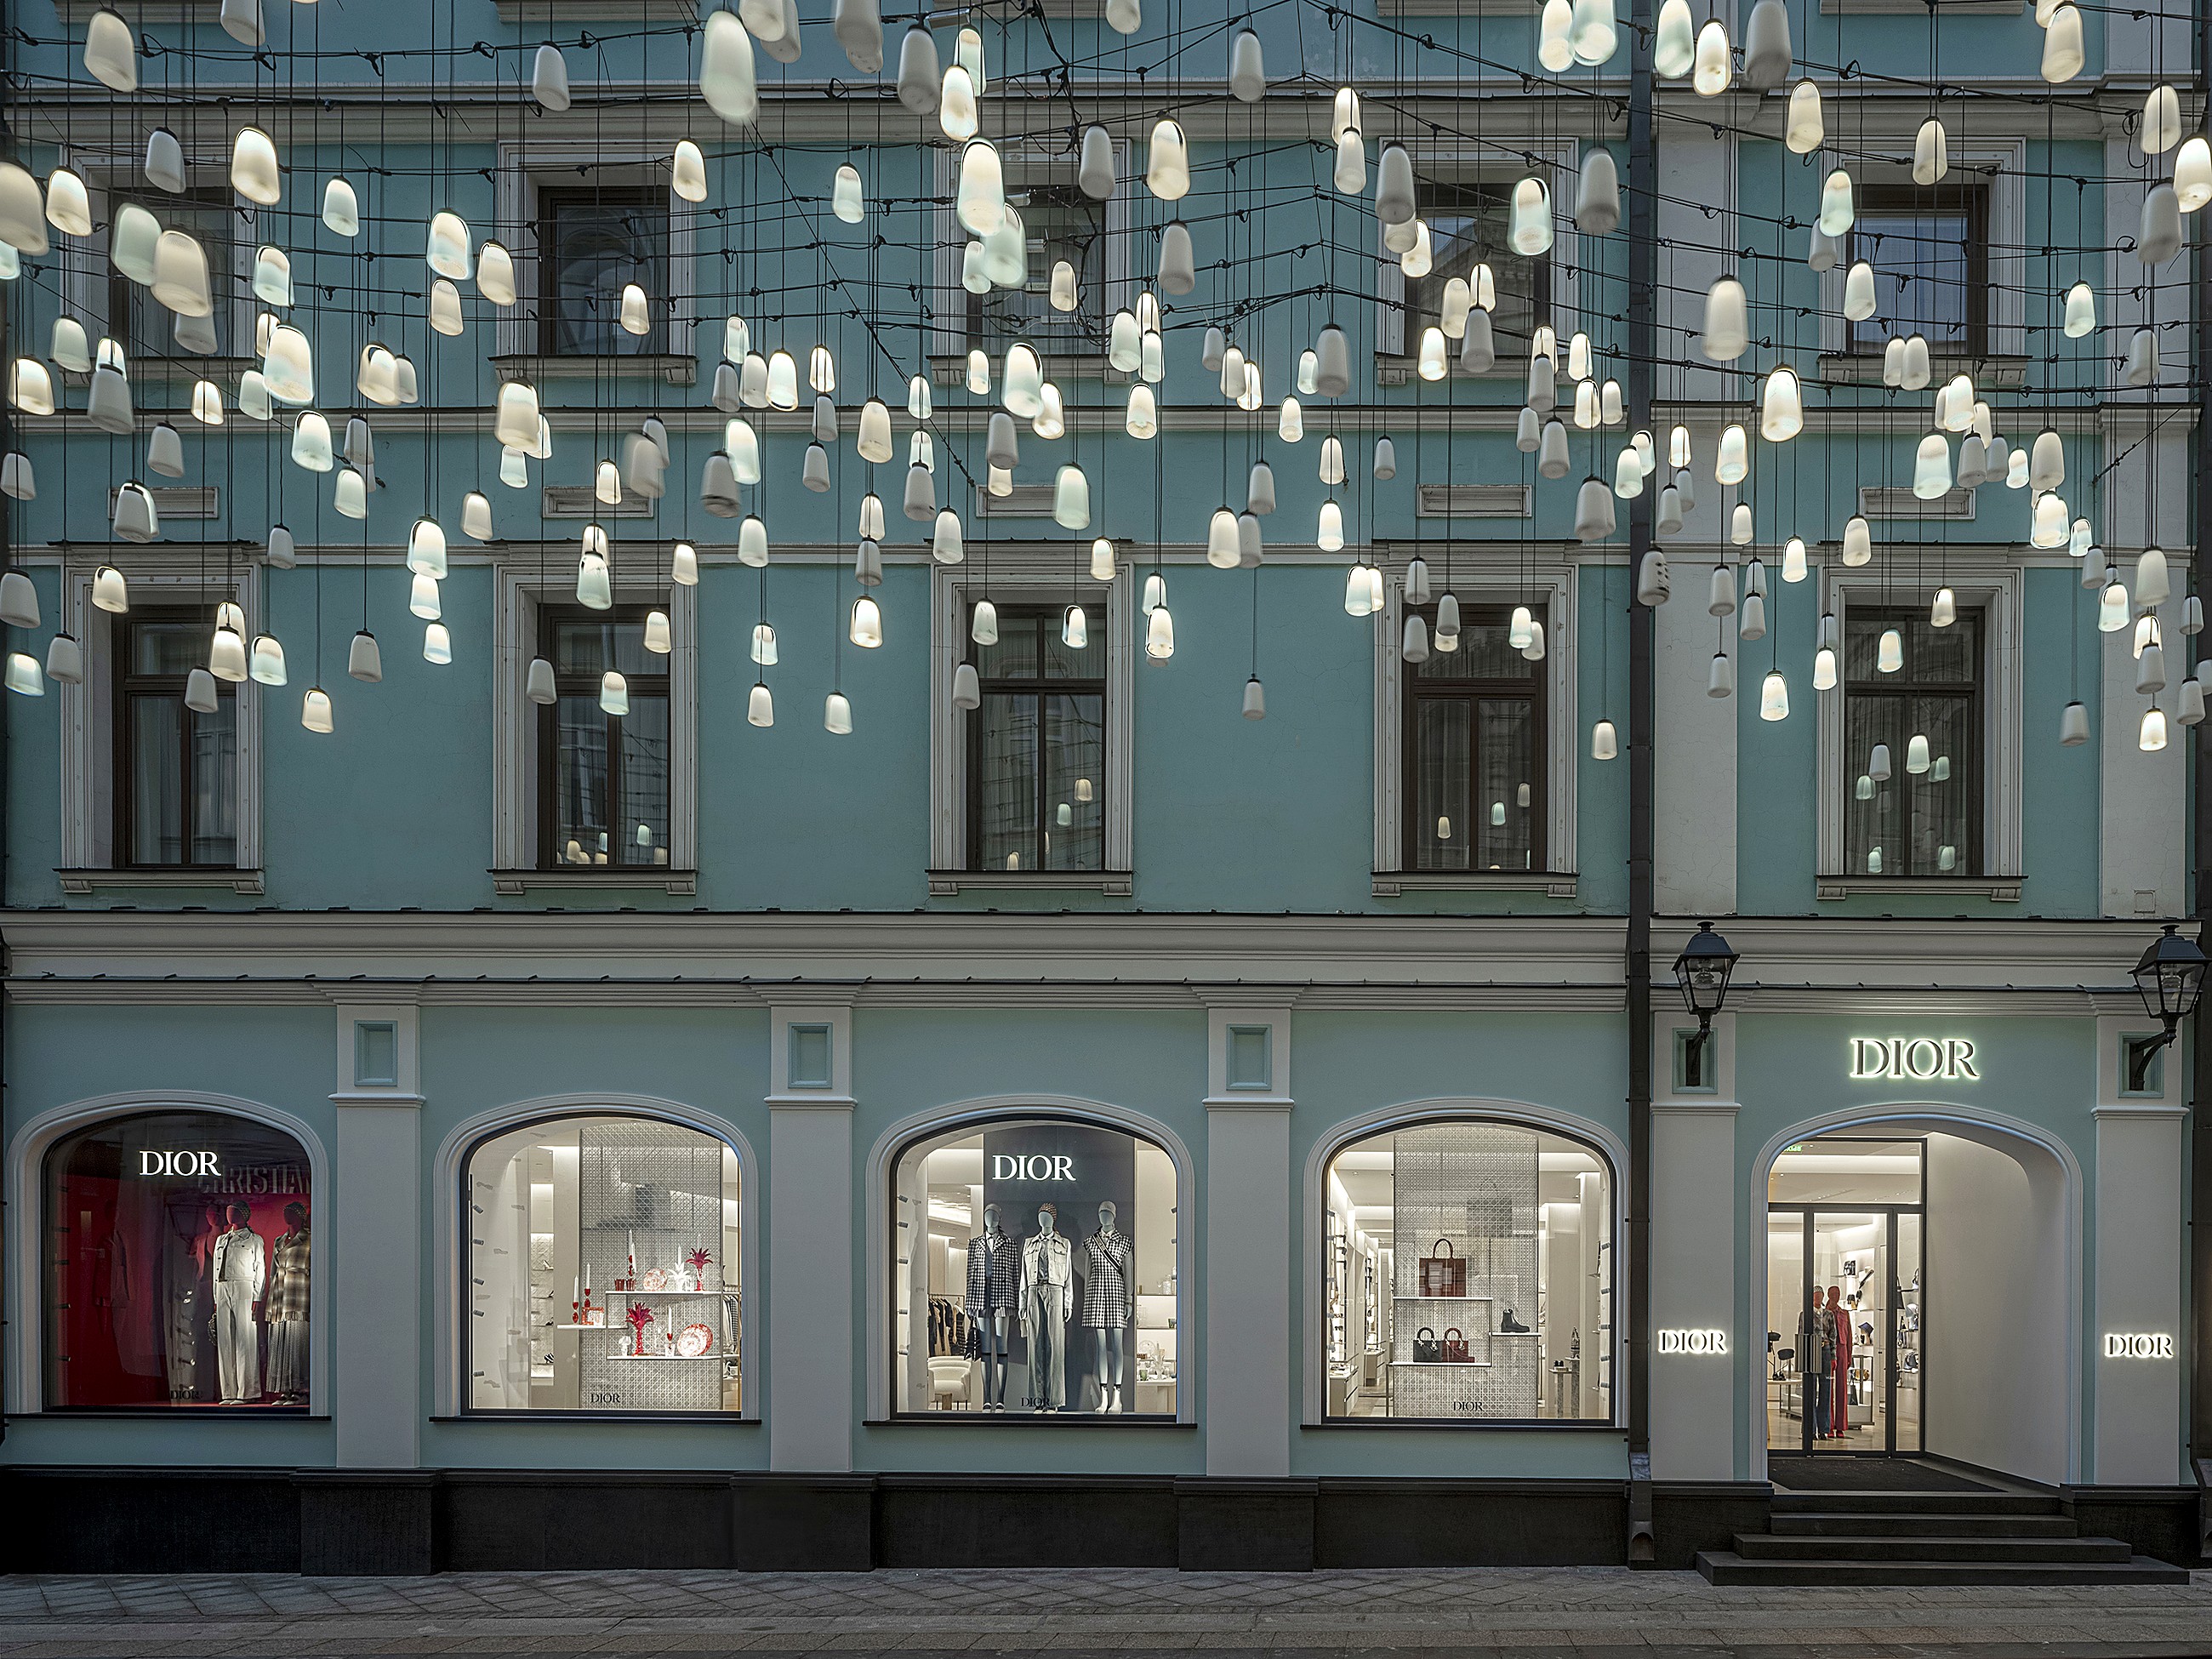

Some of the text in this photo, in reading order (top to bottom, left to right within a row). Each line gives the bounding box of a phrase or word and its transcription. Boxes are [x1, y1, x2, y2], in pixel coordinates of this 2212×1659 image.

[1850, 1038, 1981, 1080] DIOR
[139, 1150, 222, 1177] DIOR
[992, 1154, 1077, 1181] DIOR
[1658, 1330, 1727, 1354] DIOR
[2105, 1334, 2174, 1358] DIOR
[590, 1393, 620, 1403] DIOR
[1021, 1397, 1051, 1407] DIOR
[1453, 1401, 1483, 1411] DIOR
